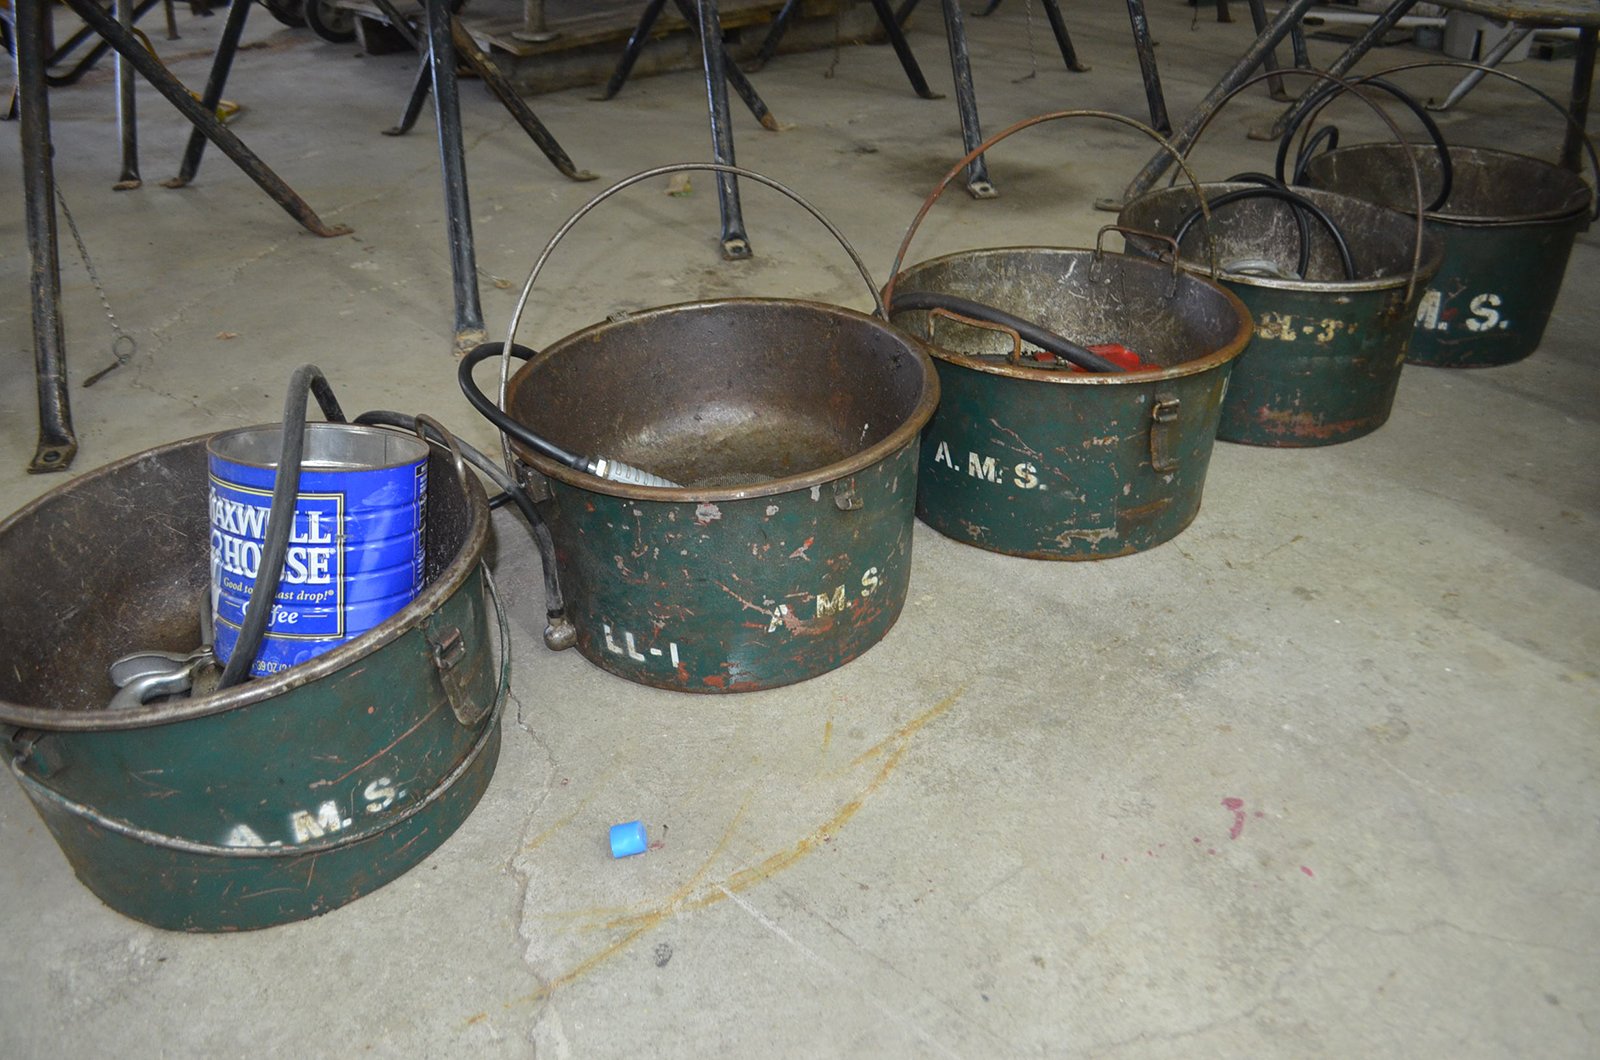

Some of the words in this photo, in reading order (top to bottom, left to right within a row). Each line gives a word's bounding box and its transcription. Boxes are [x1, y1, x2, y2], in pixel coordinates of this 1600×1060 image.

[208, 486, 332, 544] AXWLL
[221, 533, 331, 584] HOSE
[223, 577, 243, 592] Good
[275, 590, 294, 600] ast
[242, 600, 299, 627] Cfee
